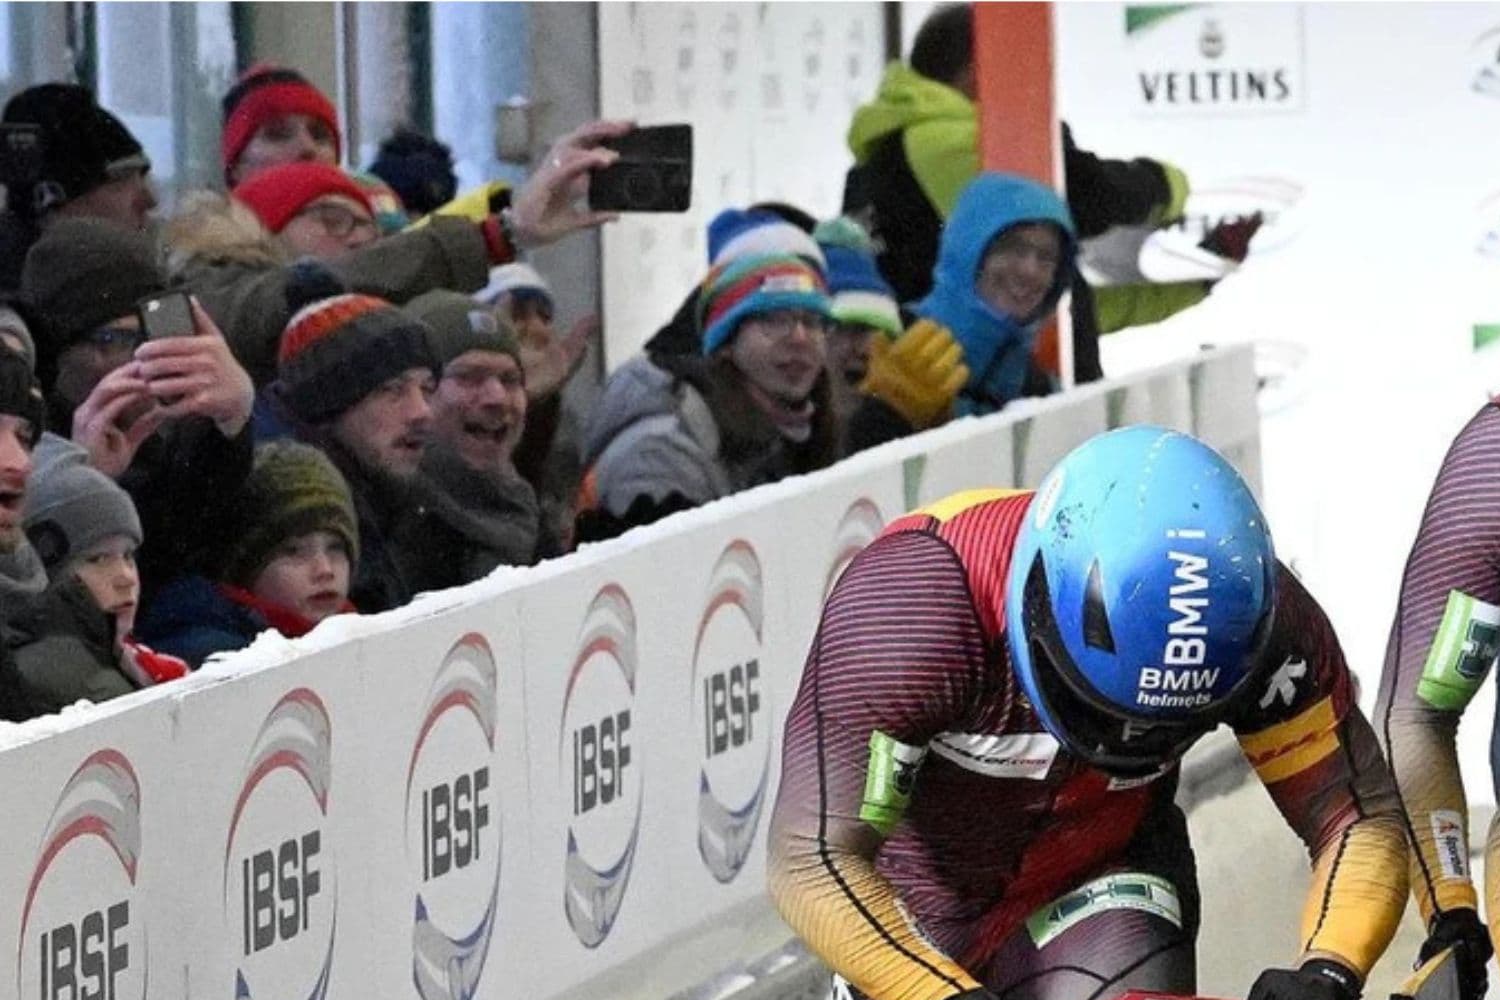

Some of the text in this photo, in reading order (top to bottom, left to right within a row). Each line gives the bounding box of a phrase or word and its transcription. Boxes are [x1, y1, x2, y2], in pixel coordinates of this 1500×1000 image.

[1139, 68, 1289, 102] VELTINS
[1164, 528, 1209, 665] BMW i
[704, 659, 761, 759] IBSF
[1136, 690, 1213, 708] helmets
[1139, 667, 1221, 691] BMW
[573, 709, 631, 816] IBSF
[423, 766, 489, 881] IBSF
[243, 829, 321, 956] IBSF
